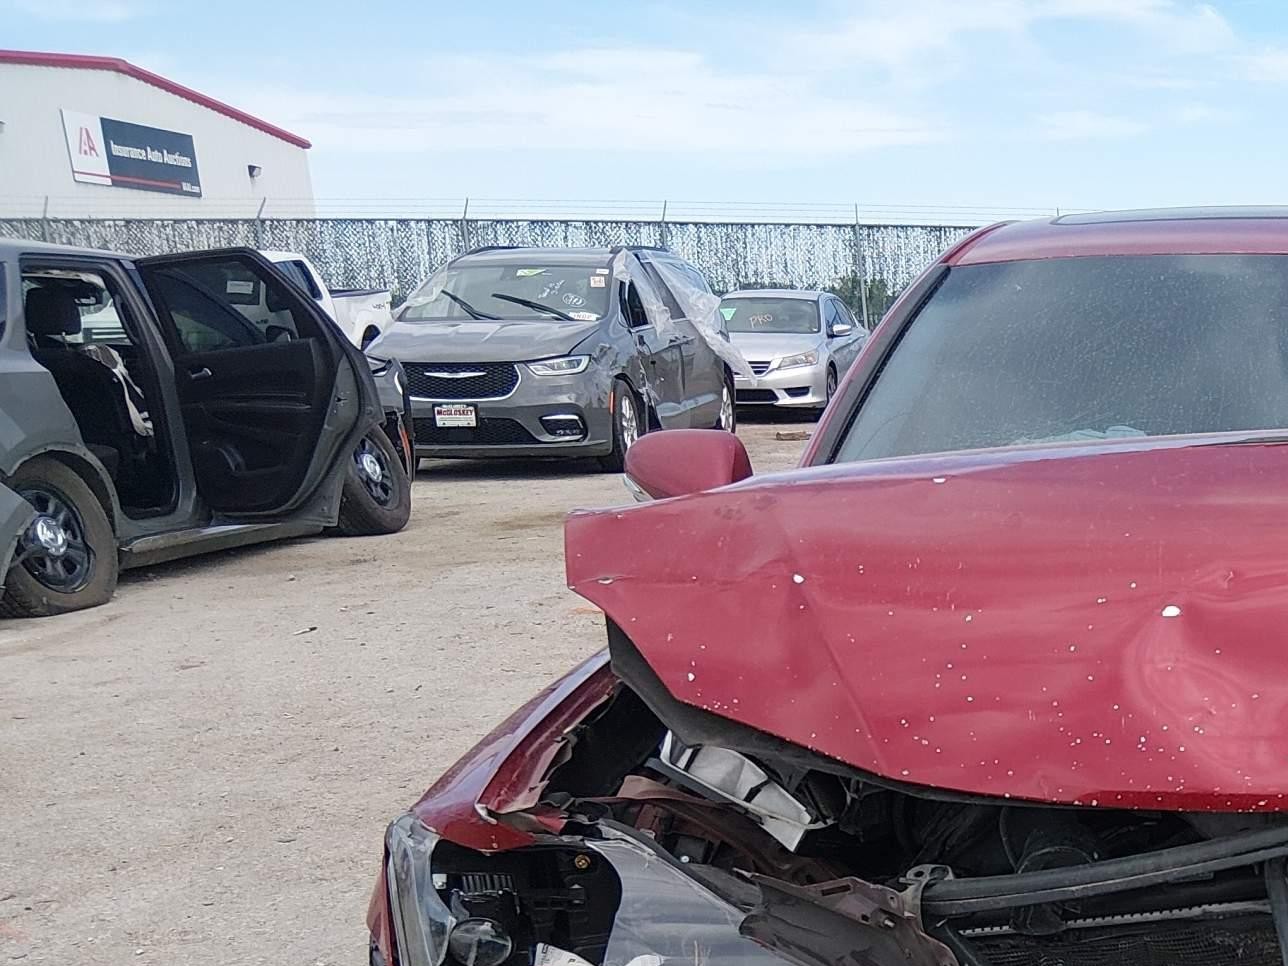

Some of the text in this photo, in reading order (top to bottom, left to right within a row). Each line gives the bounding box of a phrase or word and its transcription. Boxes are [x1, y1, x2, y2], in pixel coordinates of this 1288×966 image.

[109, 140, 193, 168] Insurance Auto Auctions
